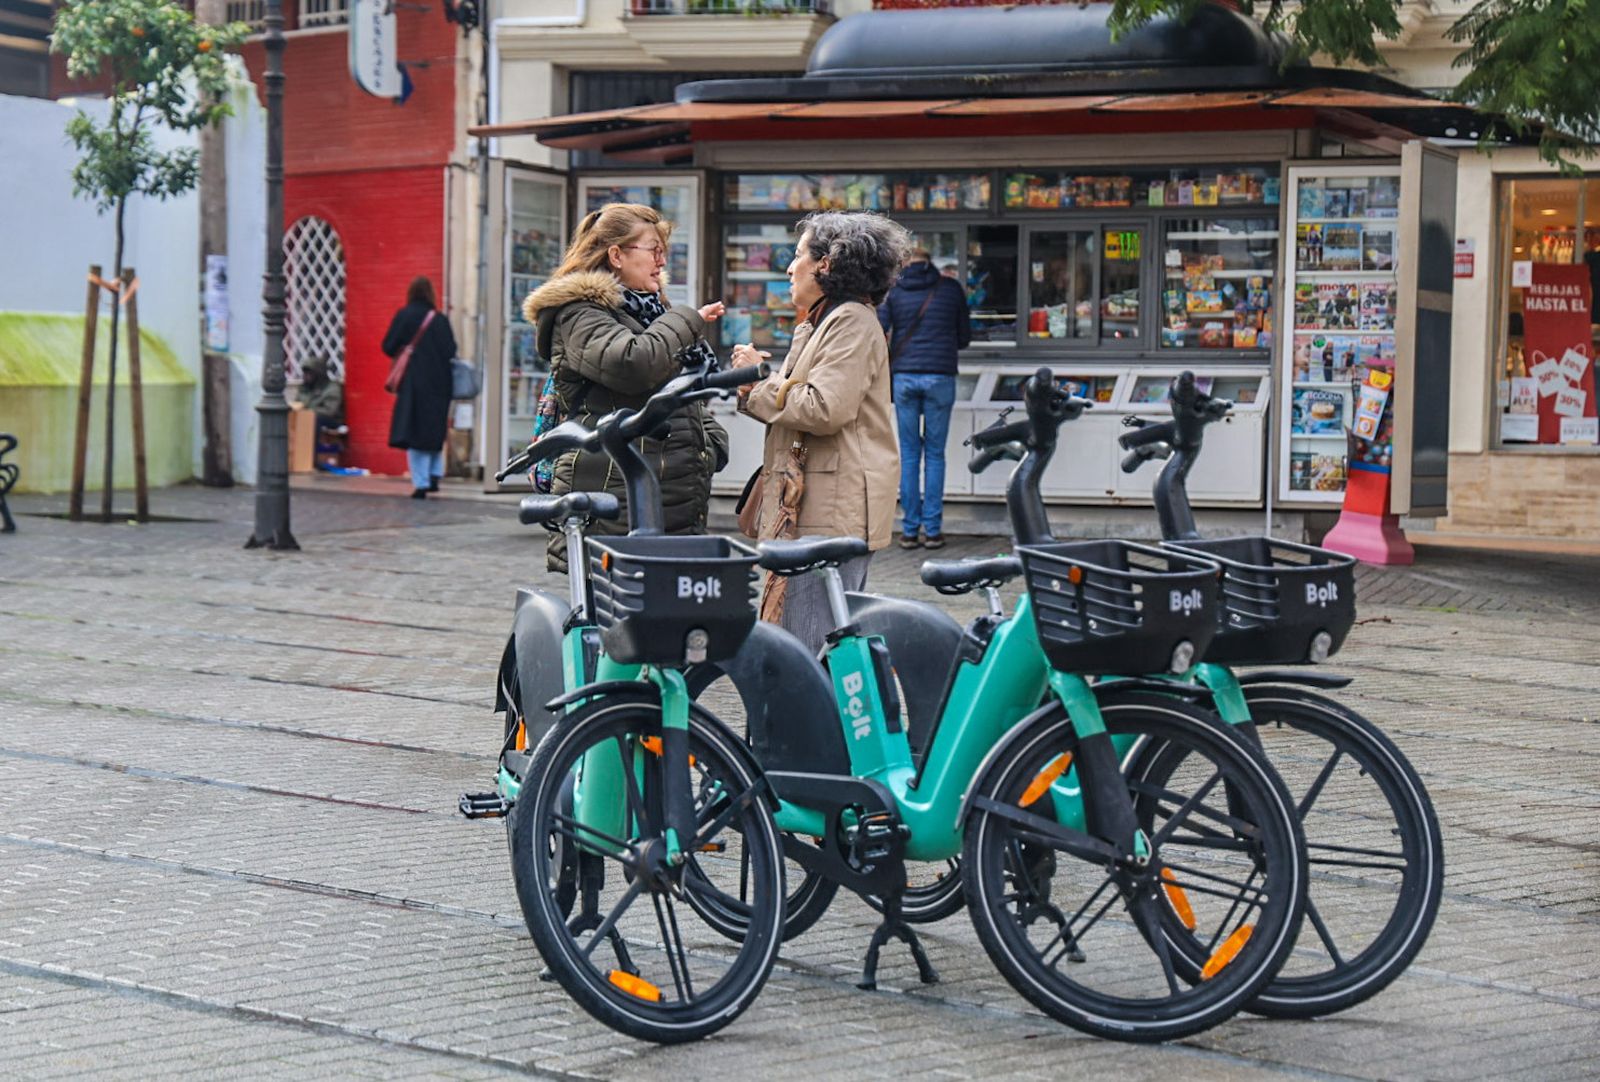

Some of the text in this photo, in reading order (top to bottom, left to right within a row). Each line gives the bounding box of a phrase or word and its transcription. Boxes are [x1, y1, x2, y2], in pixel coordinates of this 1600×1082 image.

[1530, 283, 1581, 296] REBAJAS
[1526, 297, 1587, 313] HASTA EL
[1559, 394, 1581, 409] 30%
[677, 575, 722, 604] Bolt
[1169, 588, 1203, 617] Bolt
[1304, 580, 1339, 609] Bolt
[841, 670, 873, 741] Bolt
